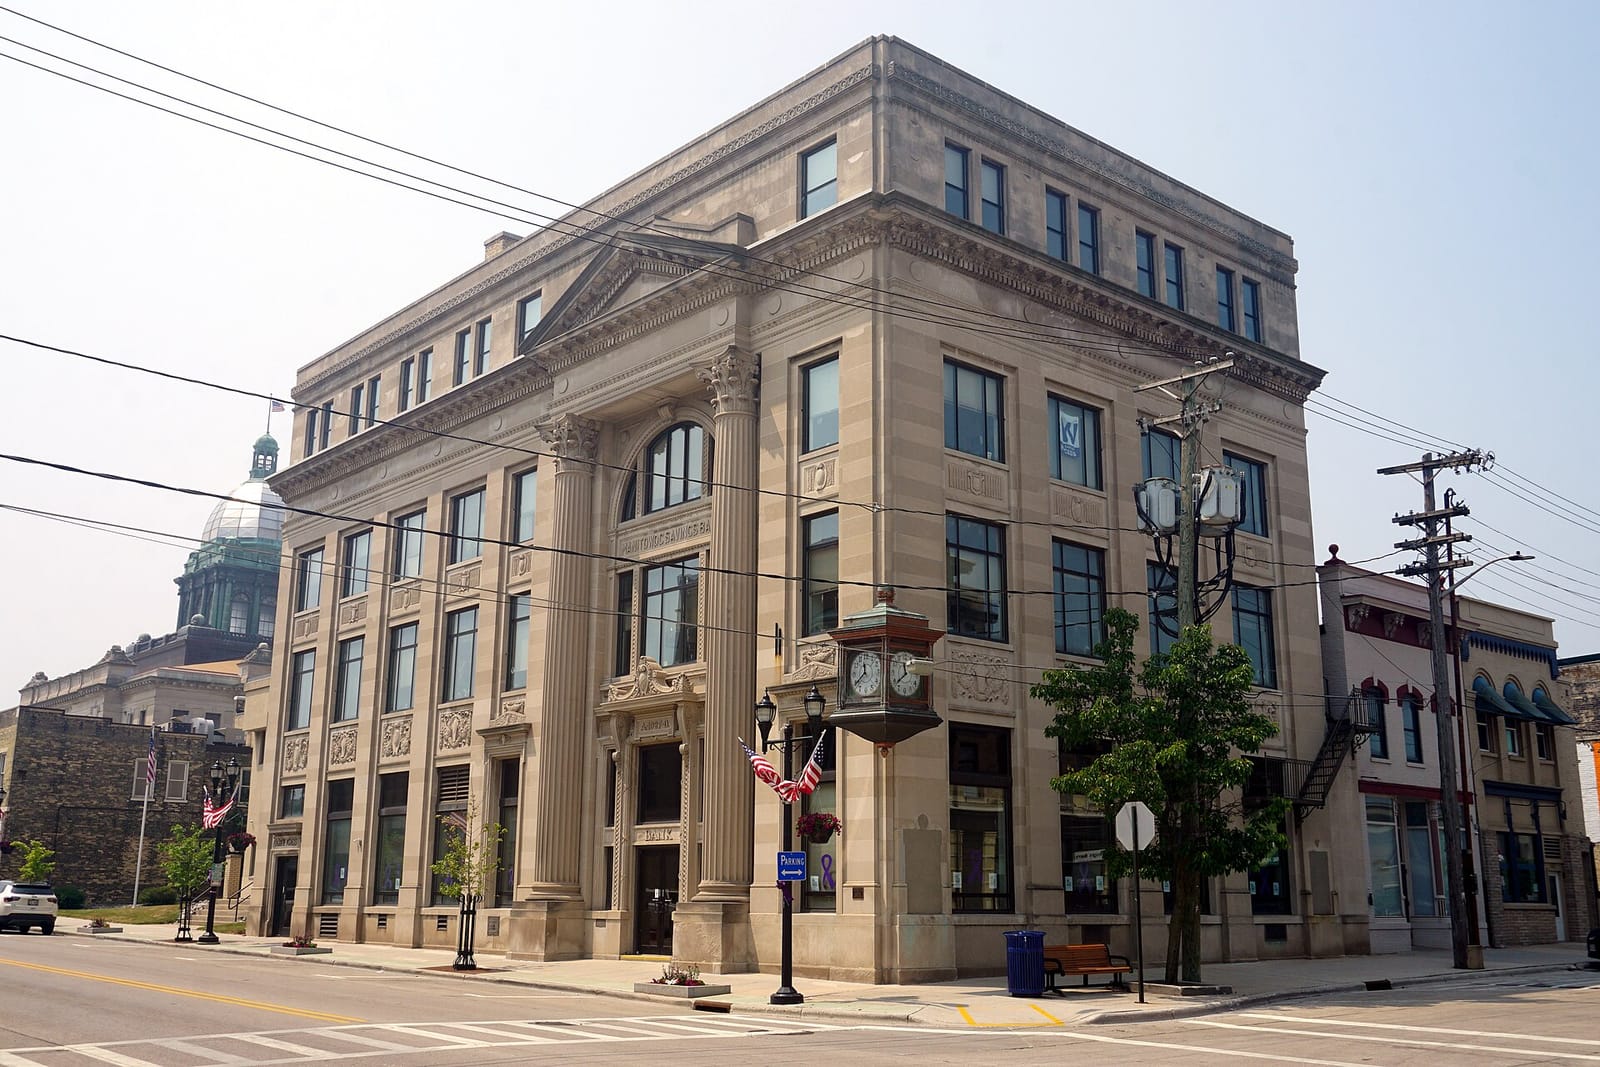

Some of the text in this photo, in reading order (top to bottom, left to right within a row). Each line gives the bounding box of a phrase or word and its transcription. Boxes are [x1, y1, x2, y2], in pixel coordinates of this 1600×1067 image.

[664, 523, 699, 545] SAVINGS
[699, 519, 711, 534] BA
[645, 829, 673, 841] BANK
